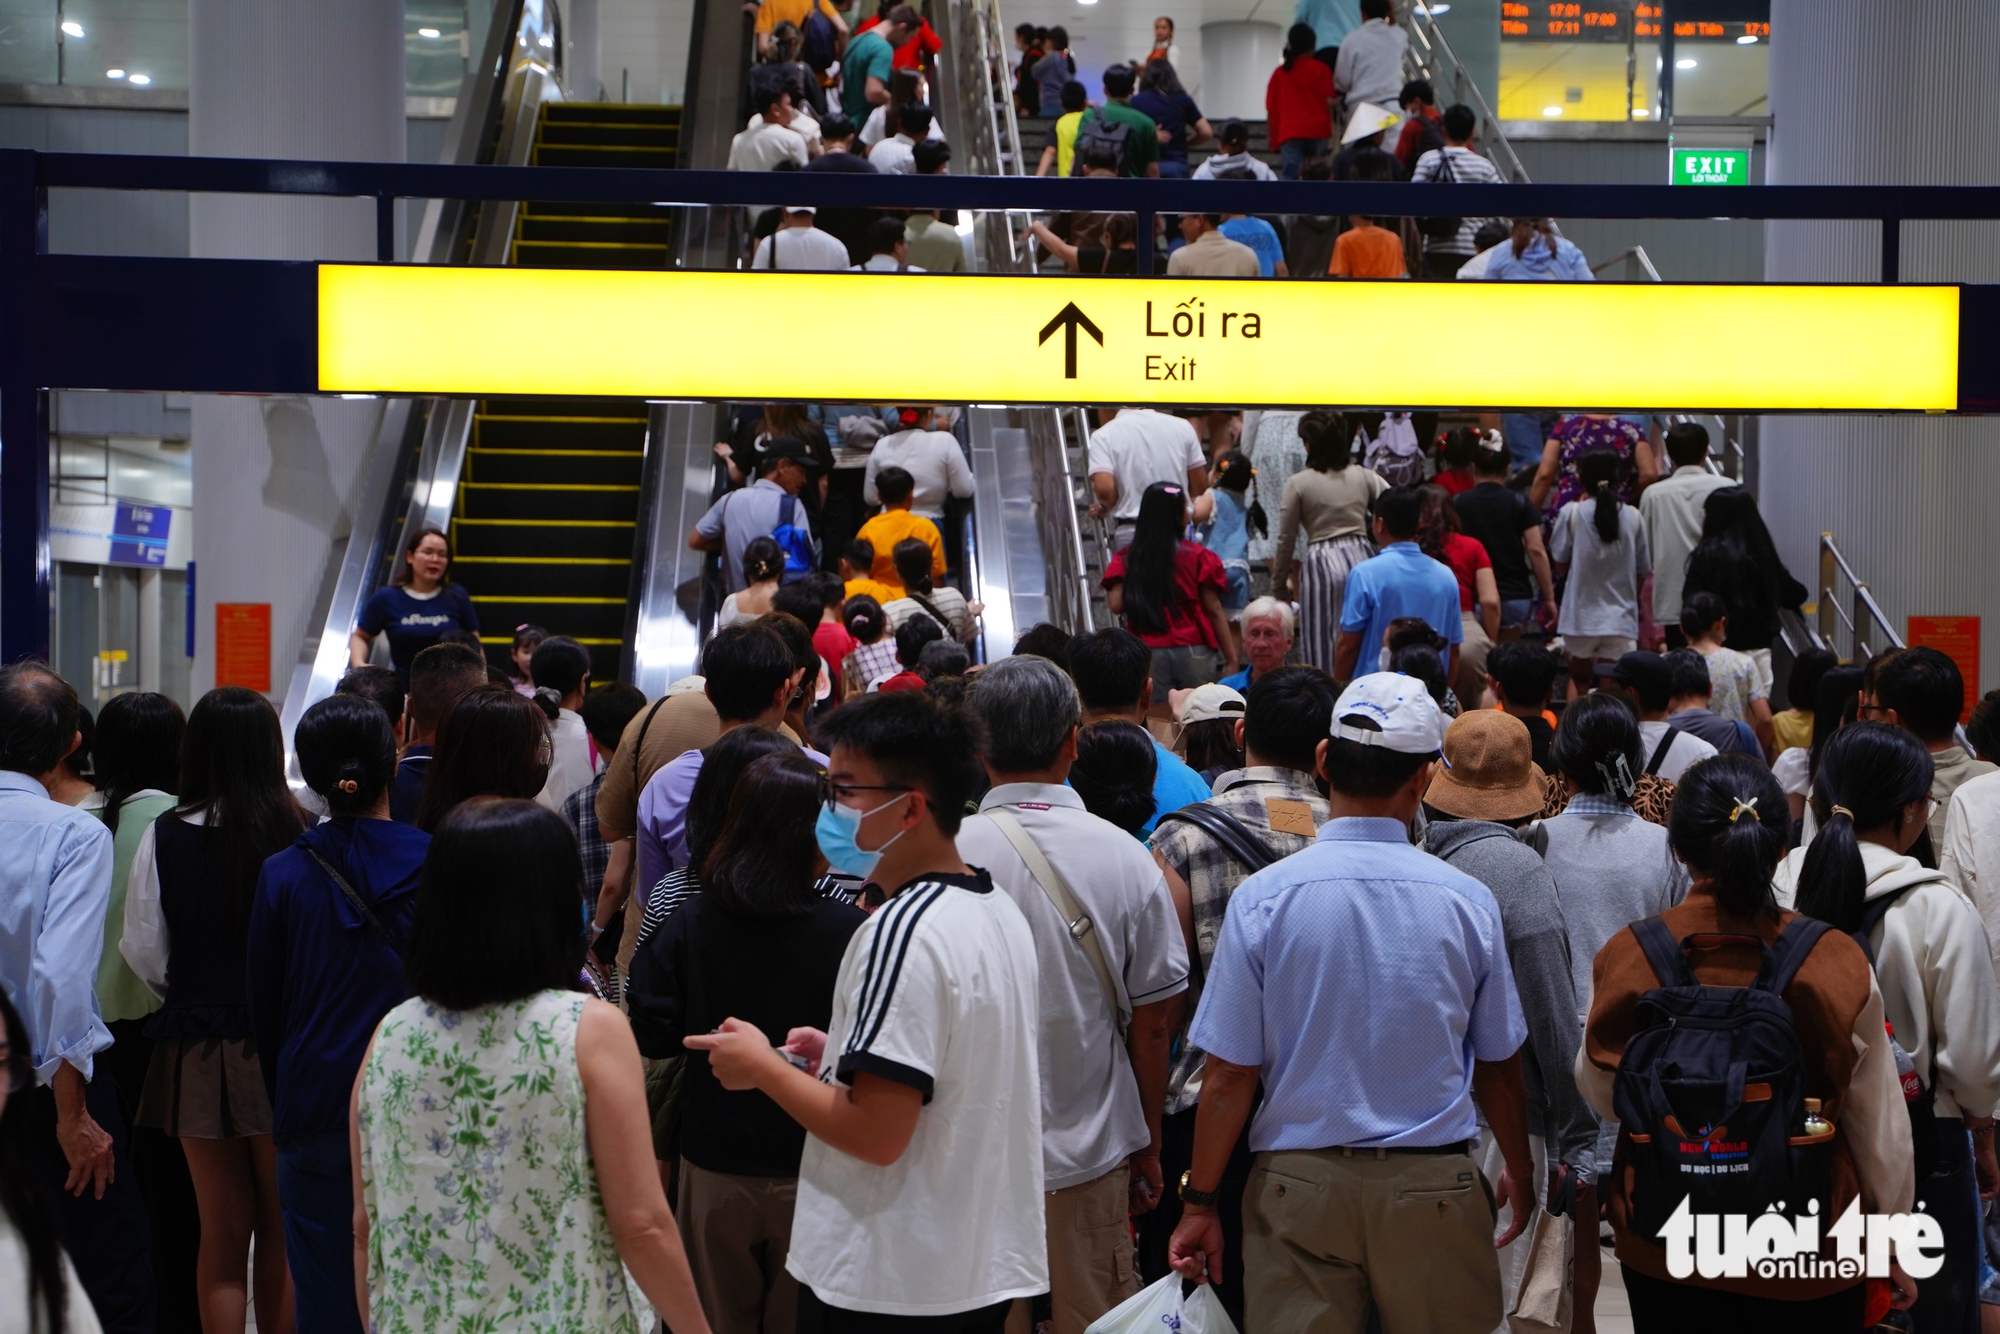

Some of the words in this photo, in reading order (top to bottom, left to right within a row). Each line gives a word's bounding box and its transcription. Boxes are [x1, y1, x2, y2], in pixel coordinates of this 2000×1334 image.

[1547, 20, 1580, 34] 17:11
[1744, 22, 1770, 36] 17:1
[1686, 157, 1736, 174] EXIT
[1146, 296, 1205, 338] Lối
[1222, 312, 1261, 339] ra
[1145, 355, 1197, 381] Exit
[1680, 1142, 1703, 1153] NEW
[1709, 1141, 1748, 1153] WORLD
[1711, 1151, 1749, 1160] EDUCATION
[1680, 1164, 1692, 1173] DU
[1693, 1165, 1710, 1175] HỌC
[1717, 1165, 1728, 1173] DU
[1730, 1163, 1749, 1173] LỊCH
